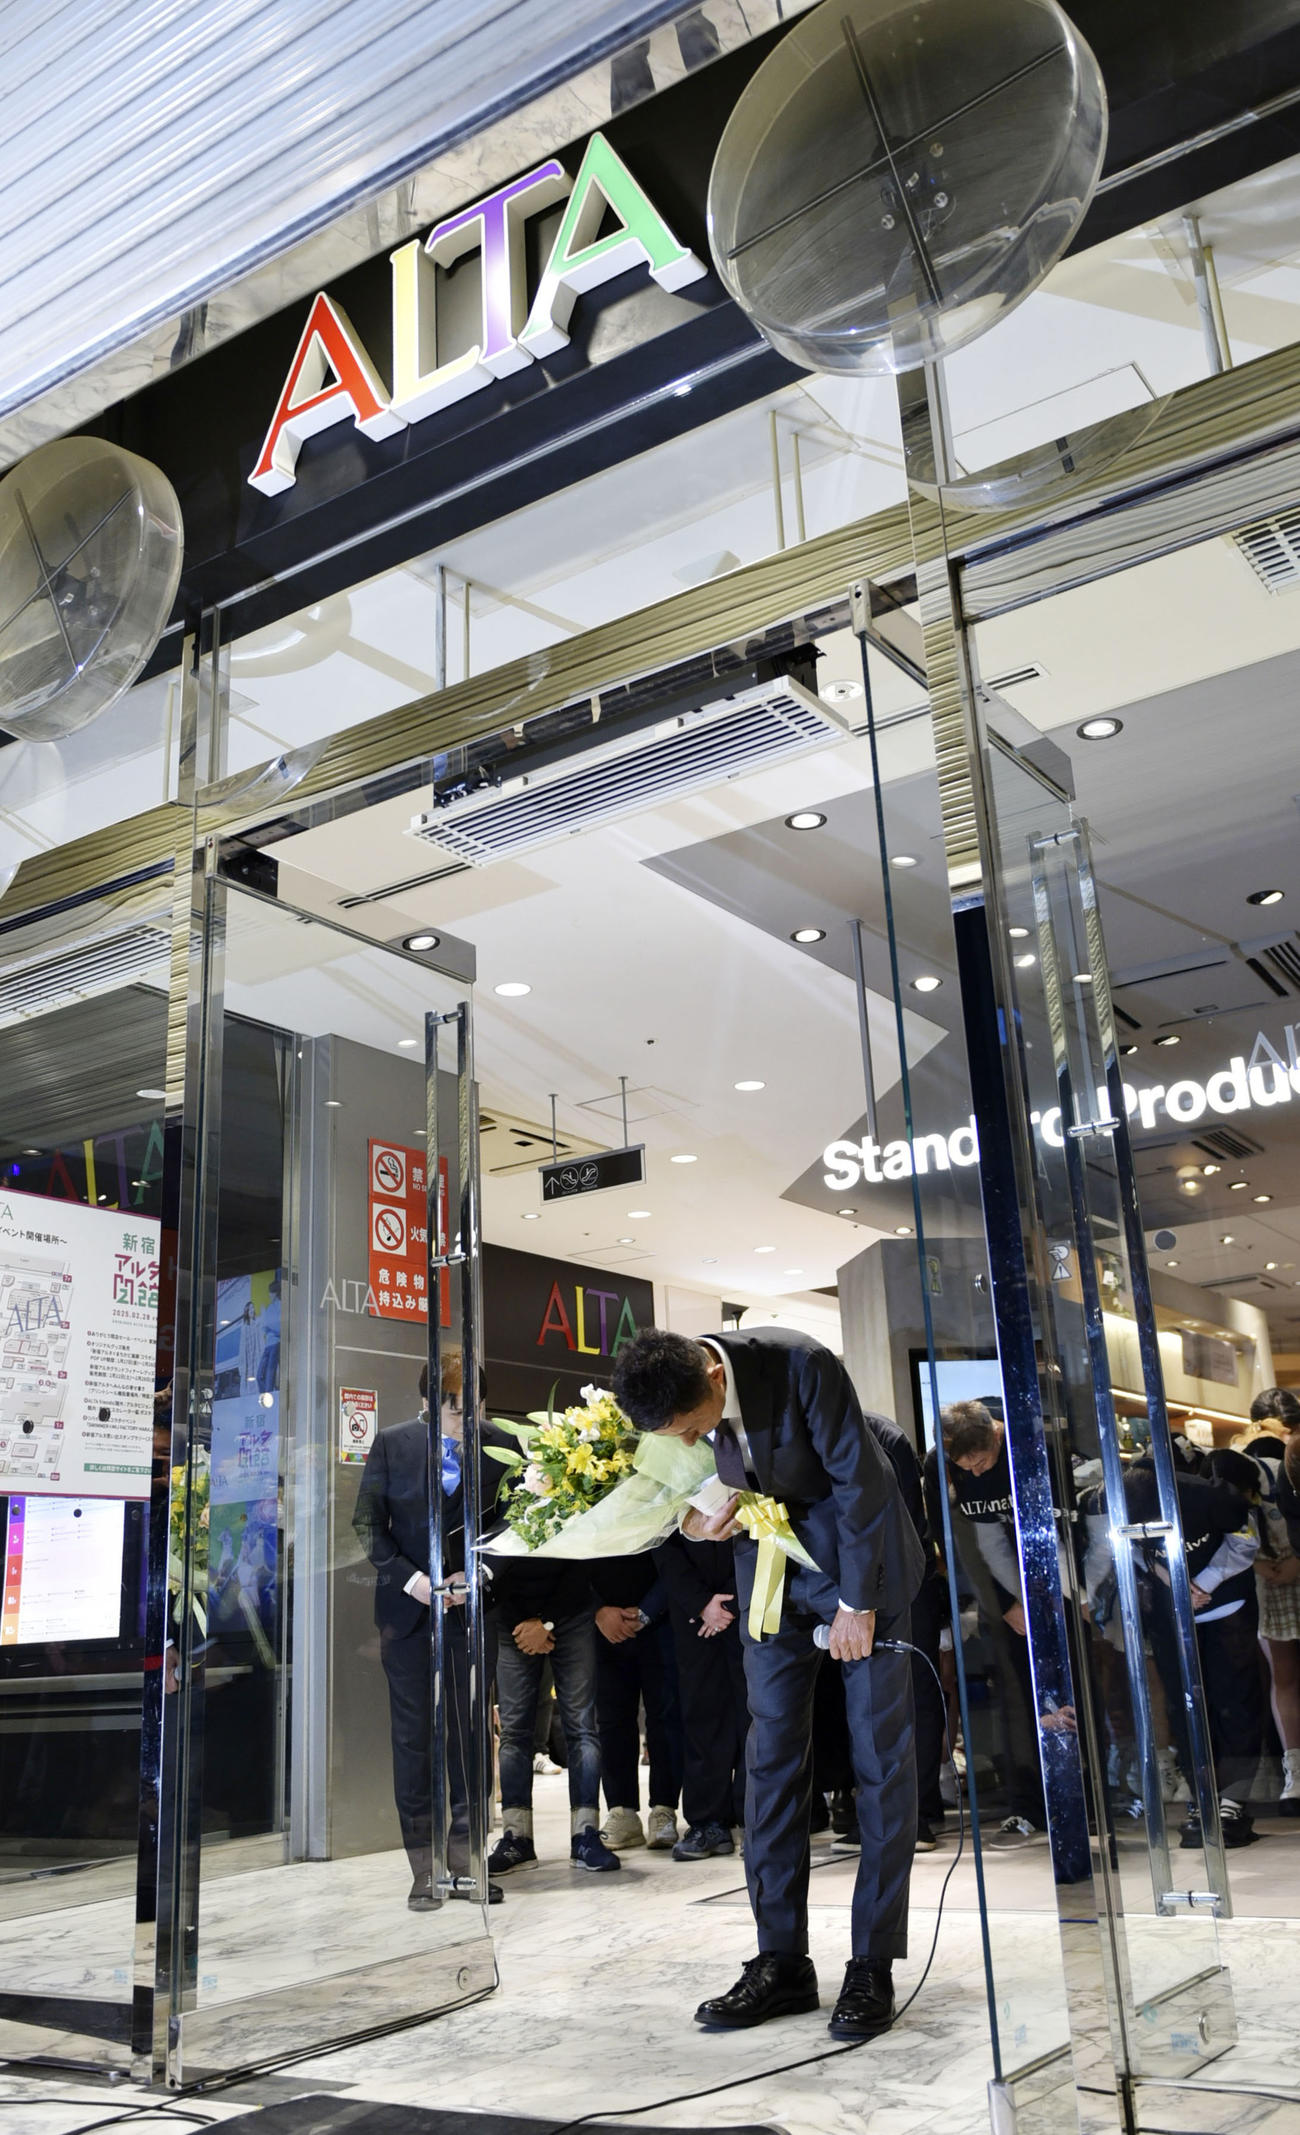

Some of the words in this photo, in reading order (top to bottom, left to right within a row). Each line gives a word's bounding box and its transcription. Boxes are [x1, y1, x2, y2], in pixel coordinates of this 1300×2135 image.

[247, 131, 707, 497] ALTA
[122, 1232, 156, 1255] 新宿
[320, 1277, 381, 1317] ALTA
